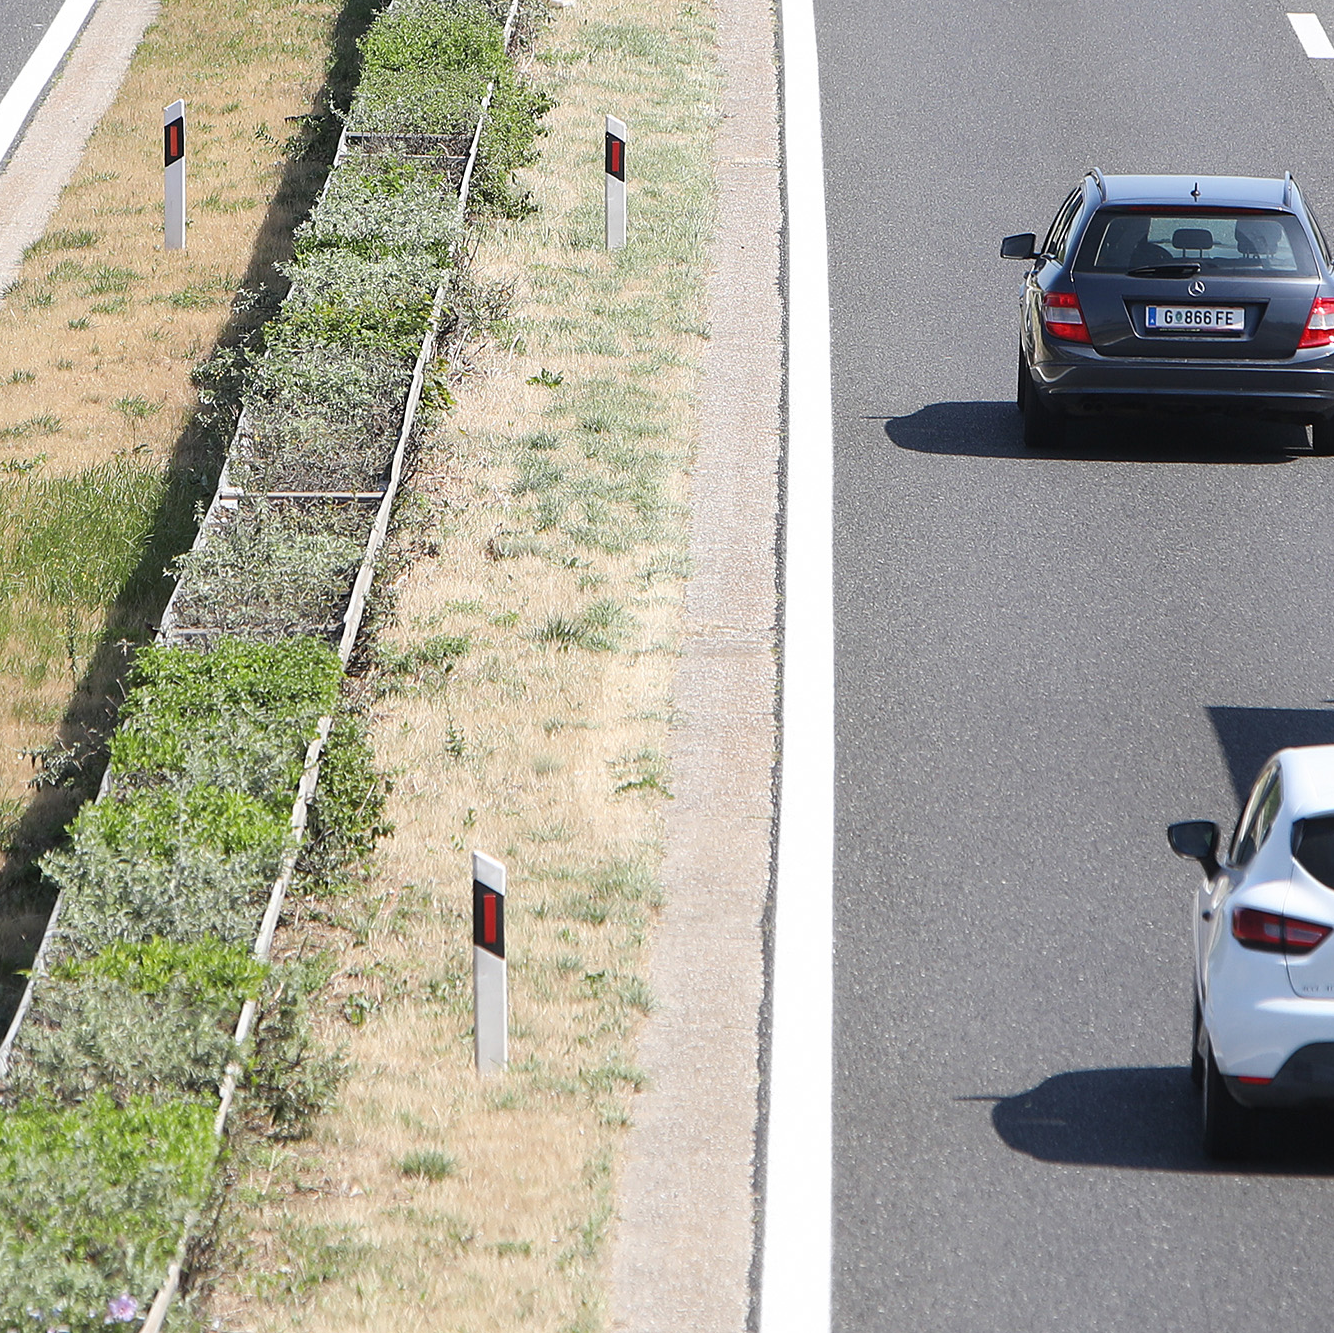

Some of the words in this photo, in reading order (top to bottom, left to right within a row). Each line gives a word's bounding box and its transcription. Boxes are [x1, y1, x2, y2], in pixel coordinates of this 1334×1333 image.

[1164, 309, 1173, 324] G
[1184, 310, 1212, 325] 866
[1216, 310, 1234, 326] FE
